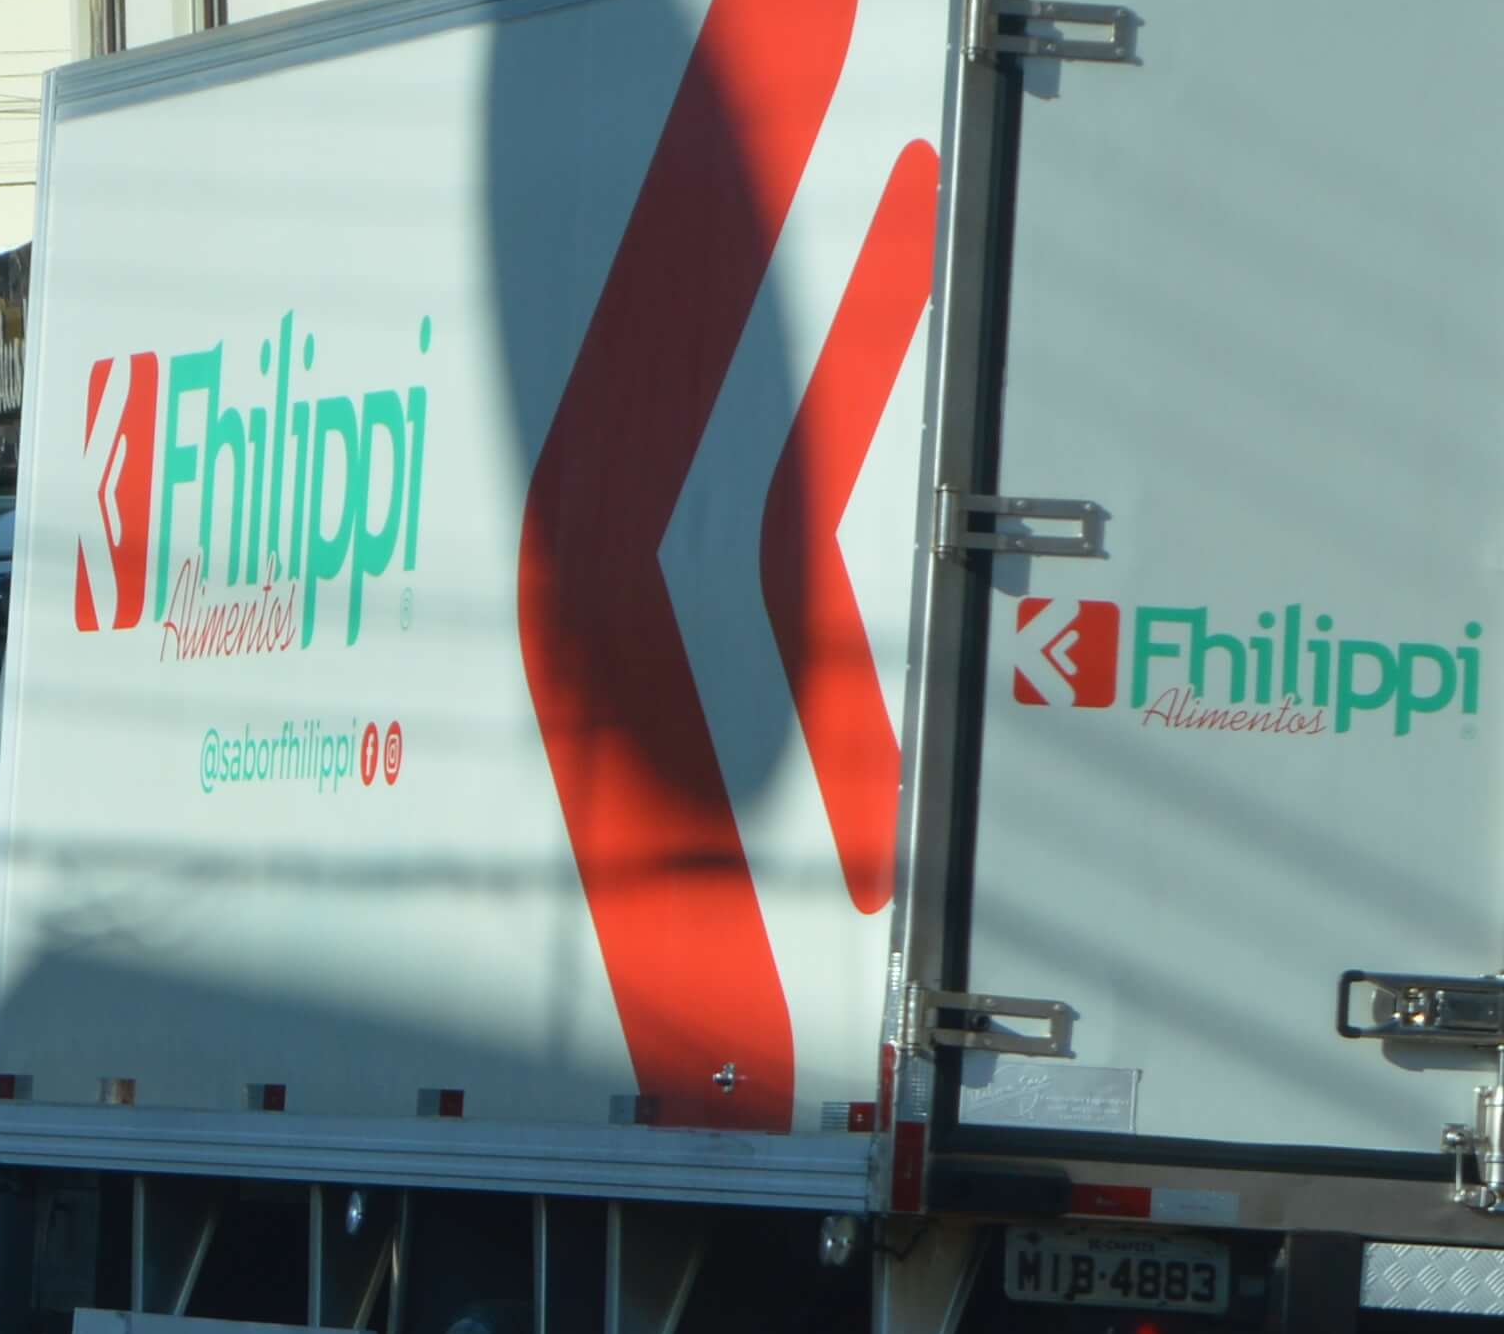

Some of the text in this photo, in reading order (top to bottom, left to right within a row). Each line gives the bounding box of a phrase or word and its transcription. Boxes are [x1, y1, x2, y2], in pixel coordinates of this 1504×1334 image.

[155, 309, 433, 650] Fhilippi
[159, 559, 298, 663] Alimentos
[1130, 603, 1483, 737] Fhilippi
[1141, 685, 1330, 735] Alimentos
[199, 717, 358, 795] @saborfhilippi
